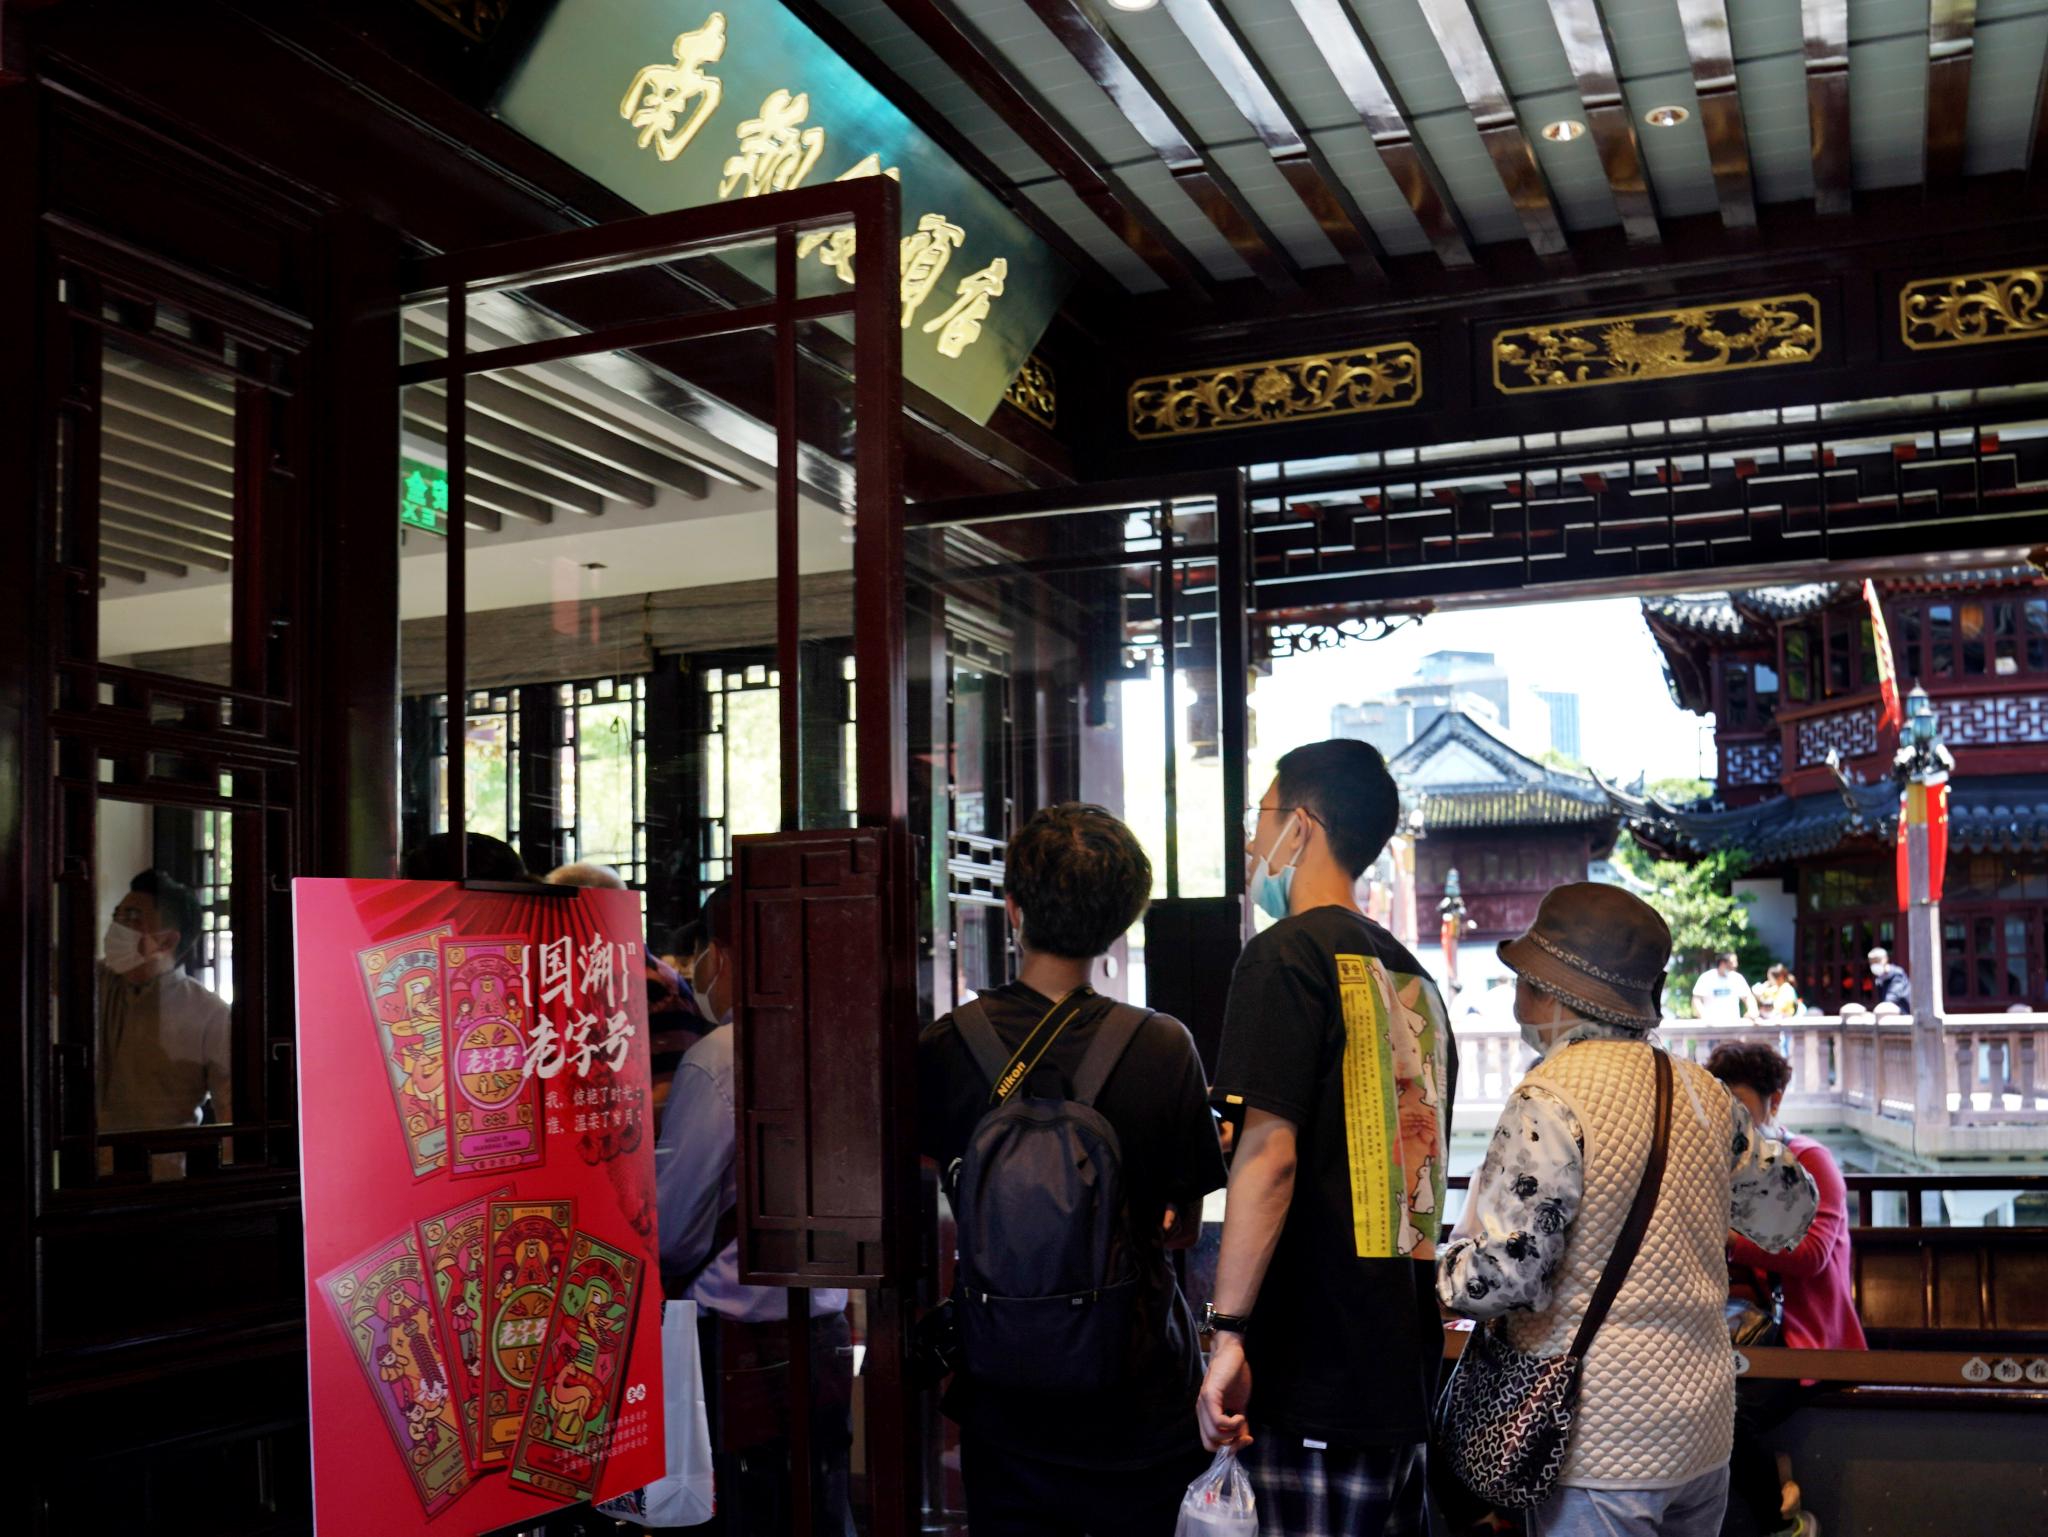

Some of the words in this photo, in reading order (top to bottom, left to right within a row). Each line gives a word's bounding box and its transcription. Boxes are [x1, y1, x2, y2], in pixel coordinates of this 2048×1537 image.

[465, 1046, 517, 1074] 老字号
[522, 1010, 636, 1079] 老字号
[997, 1061, 1027, 1097] Nikon
